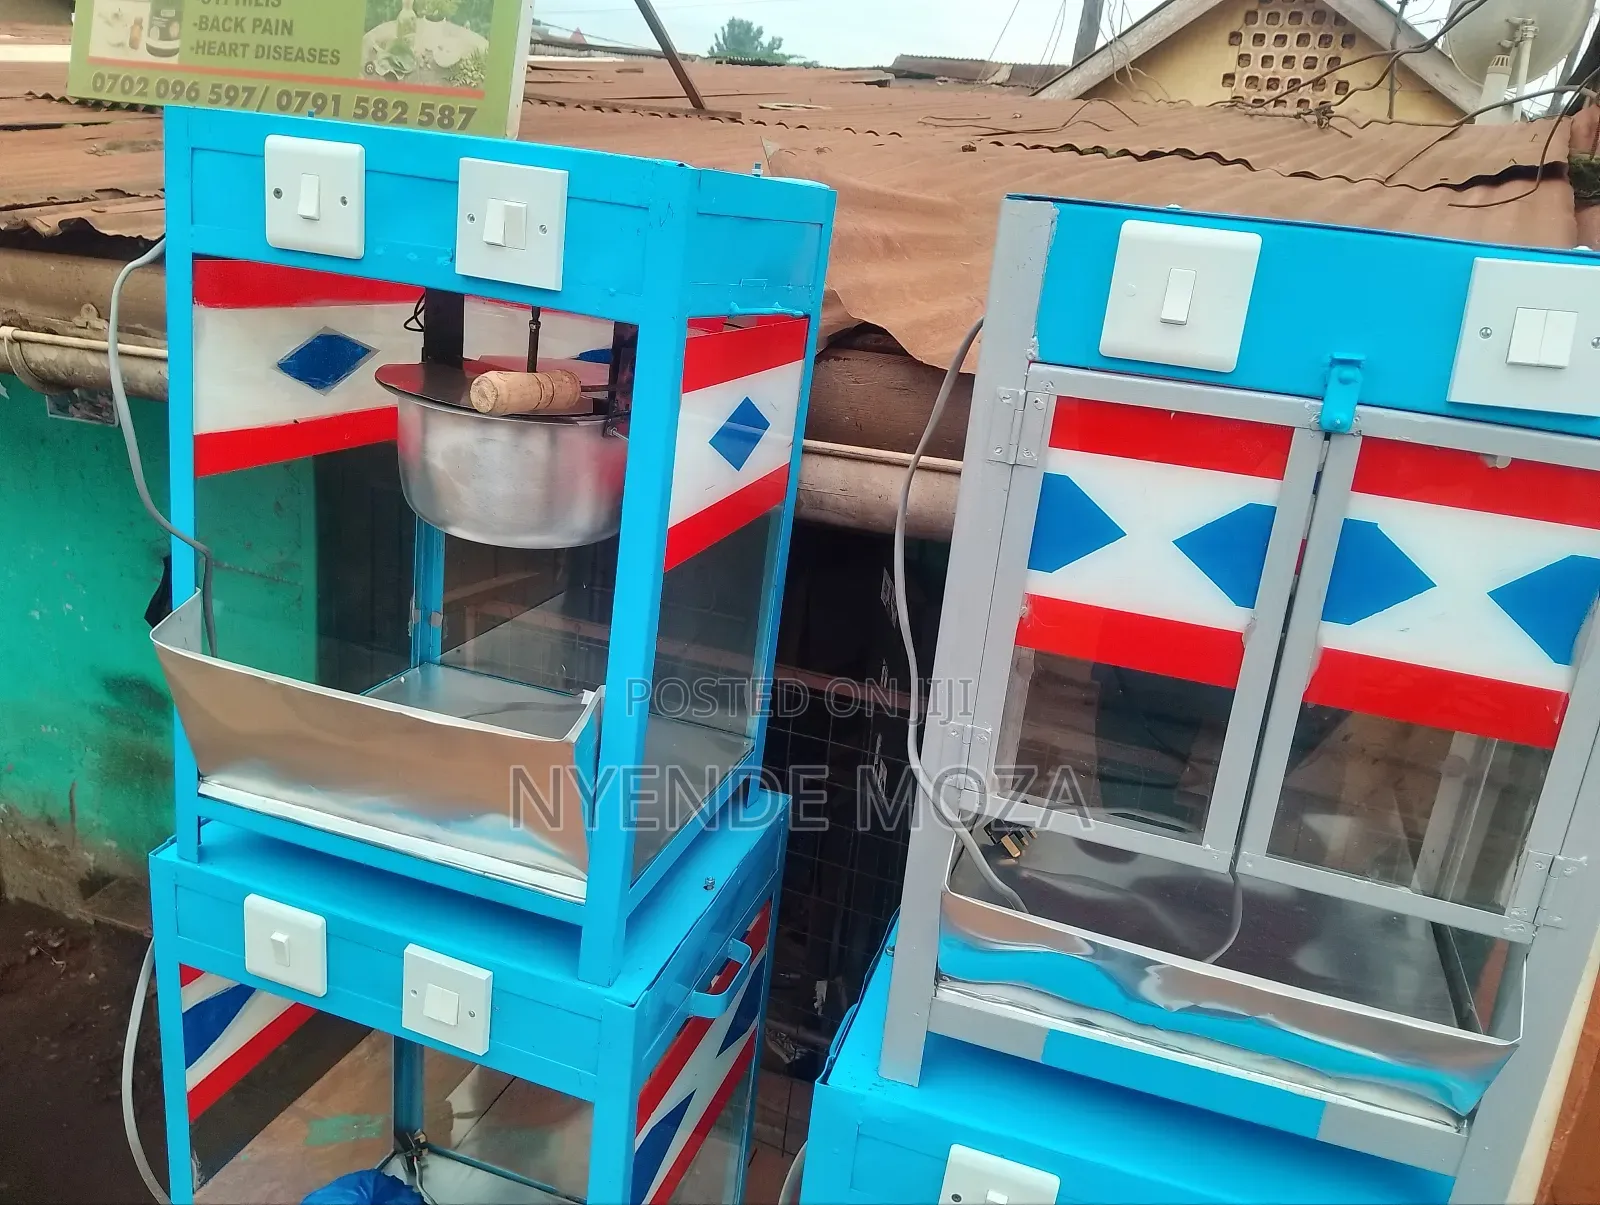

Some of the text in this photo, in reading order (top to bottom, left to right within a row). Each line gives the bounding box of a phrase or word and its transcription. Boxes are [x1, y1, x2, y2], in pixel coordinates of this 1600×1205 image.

[193, 14, 294, 36] -BACK PAIN
[190, 39, 341, 66] -HEART DISEASES
[91, 71, 149, 98] 0702
[154, 77, 201, 102] 096
[275, 89, 342, 117] 0791
[353, 96, 409, 124] 582
[417, 103, 478, 131] 587
